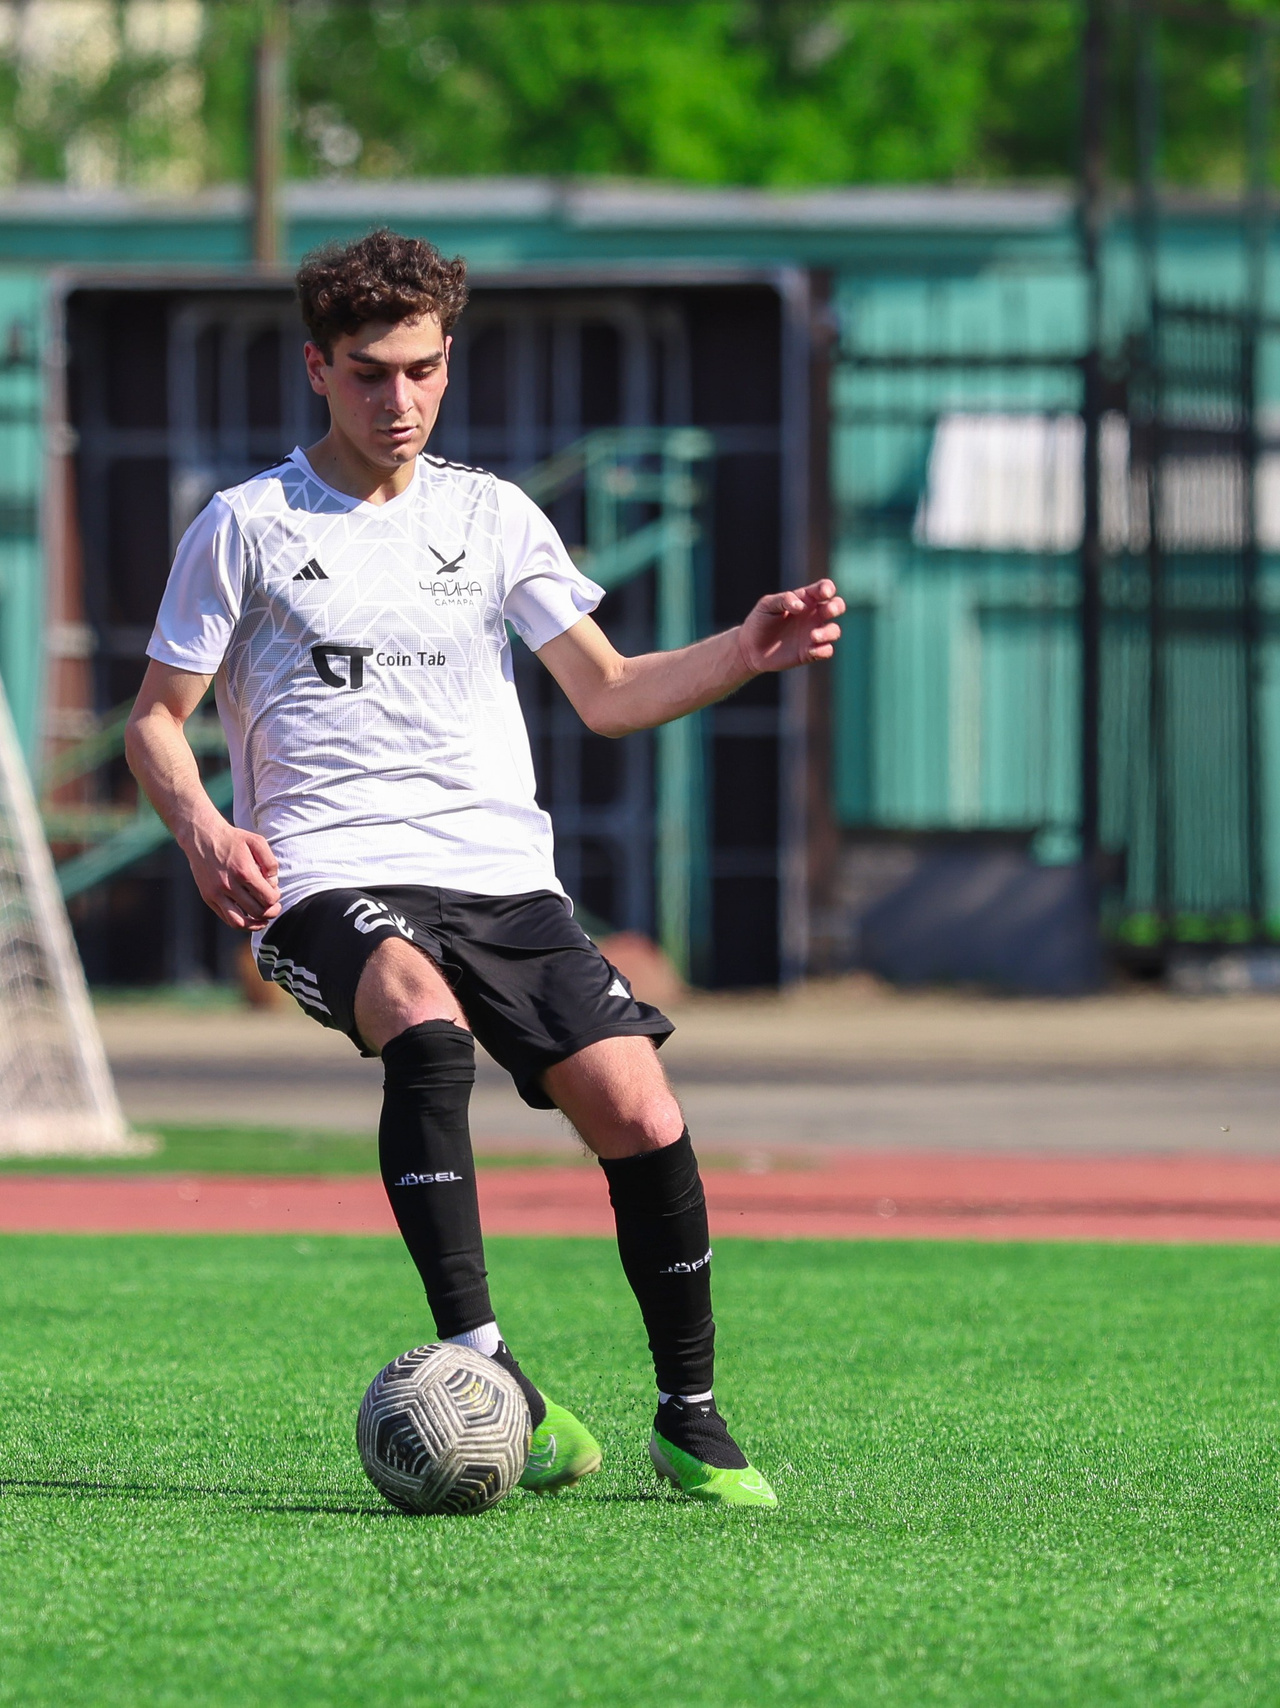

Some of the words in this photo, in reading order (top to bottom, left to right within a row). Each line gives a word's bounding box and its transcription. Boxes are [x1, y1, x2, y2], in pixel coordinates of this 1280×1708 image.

[419, 579, 483, 596] ЧАЙКА
[376, 652, 412, 666] Coin
[417, 652, 446, 666] Tab
